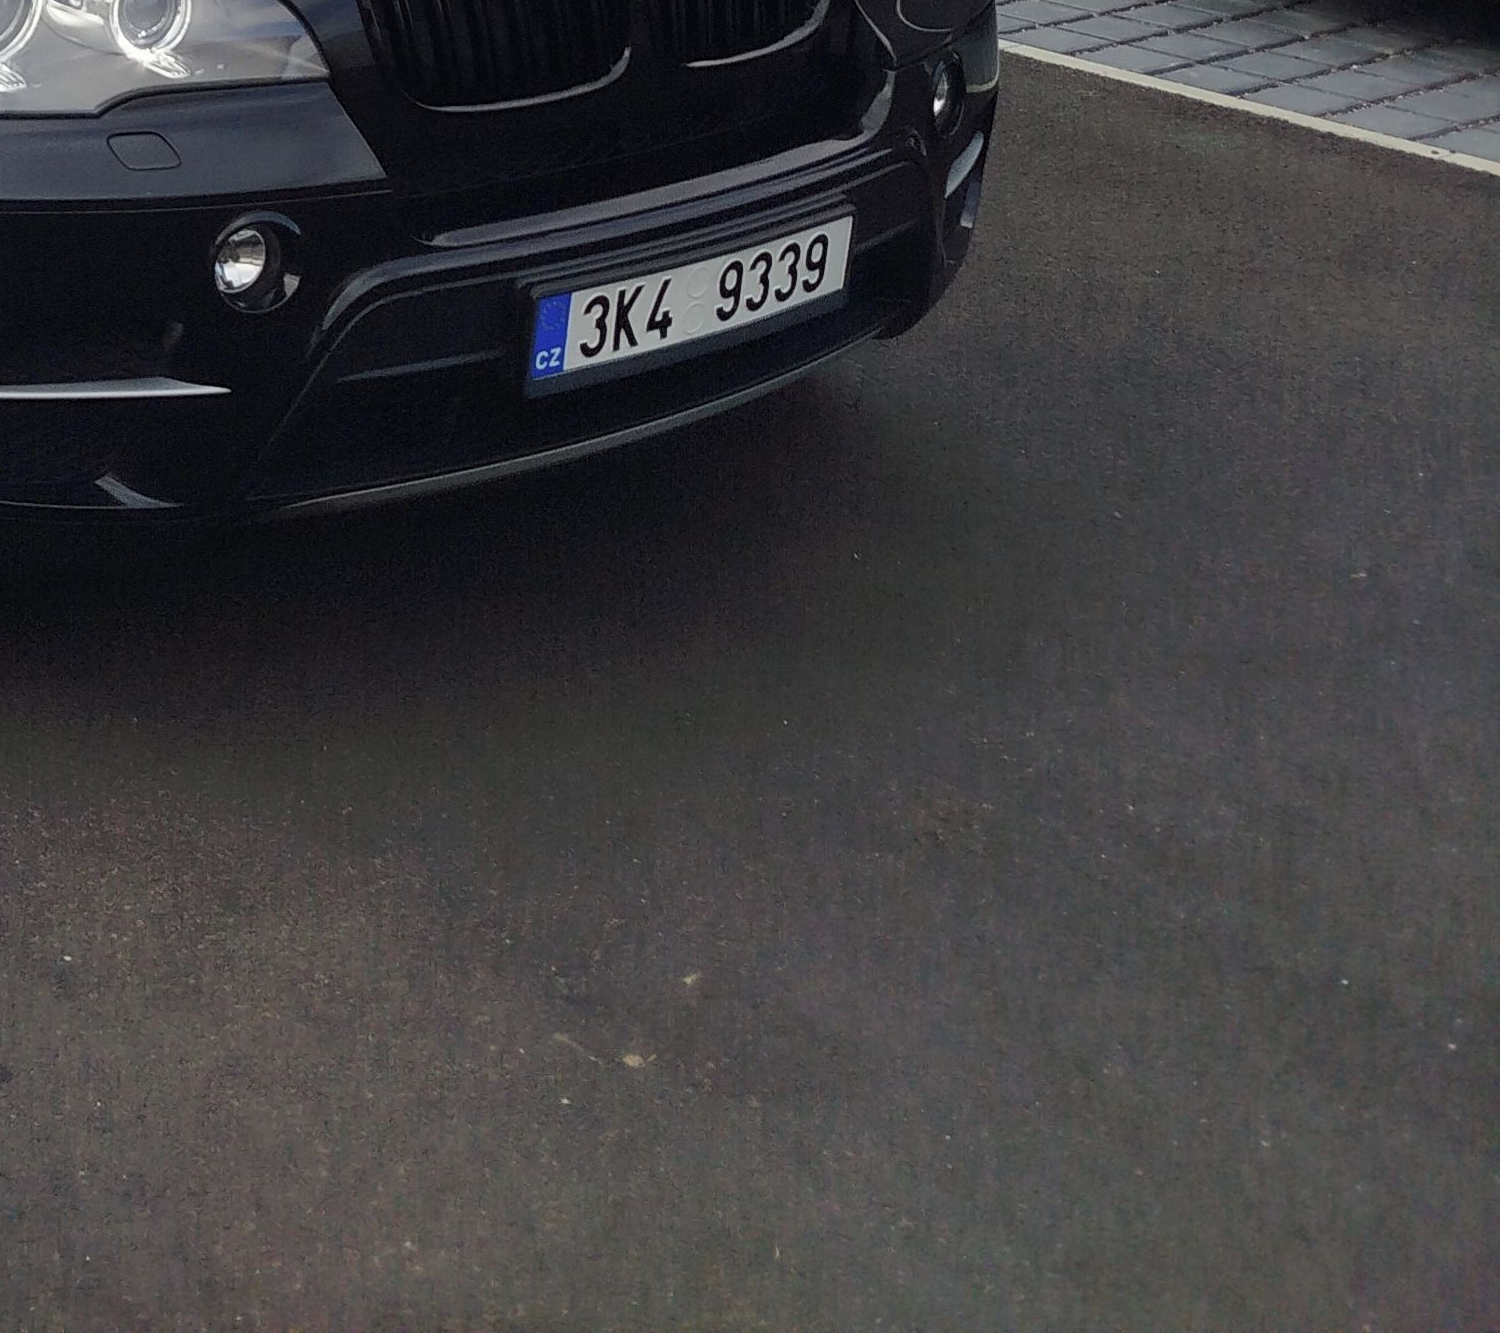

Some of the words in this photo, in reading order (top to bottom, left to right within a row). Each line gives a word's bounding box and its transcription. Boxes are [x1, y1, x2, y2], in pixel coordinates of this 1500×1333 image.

[535, 347, 561, 370] CZ
[578, 277, 674, 359] 3K4
[715, 233, 830, 322] 9339
